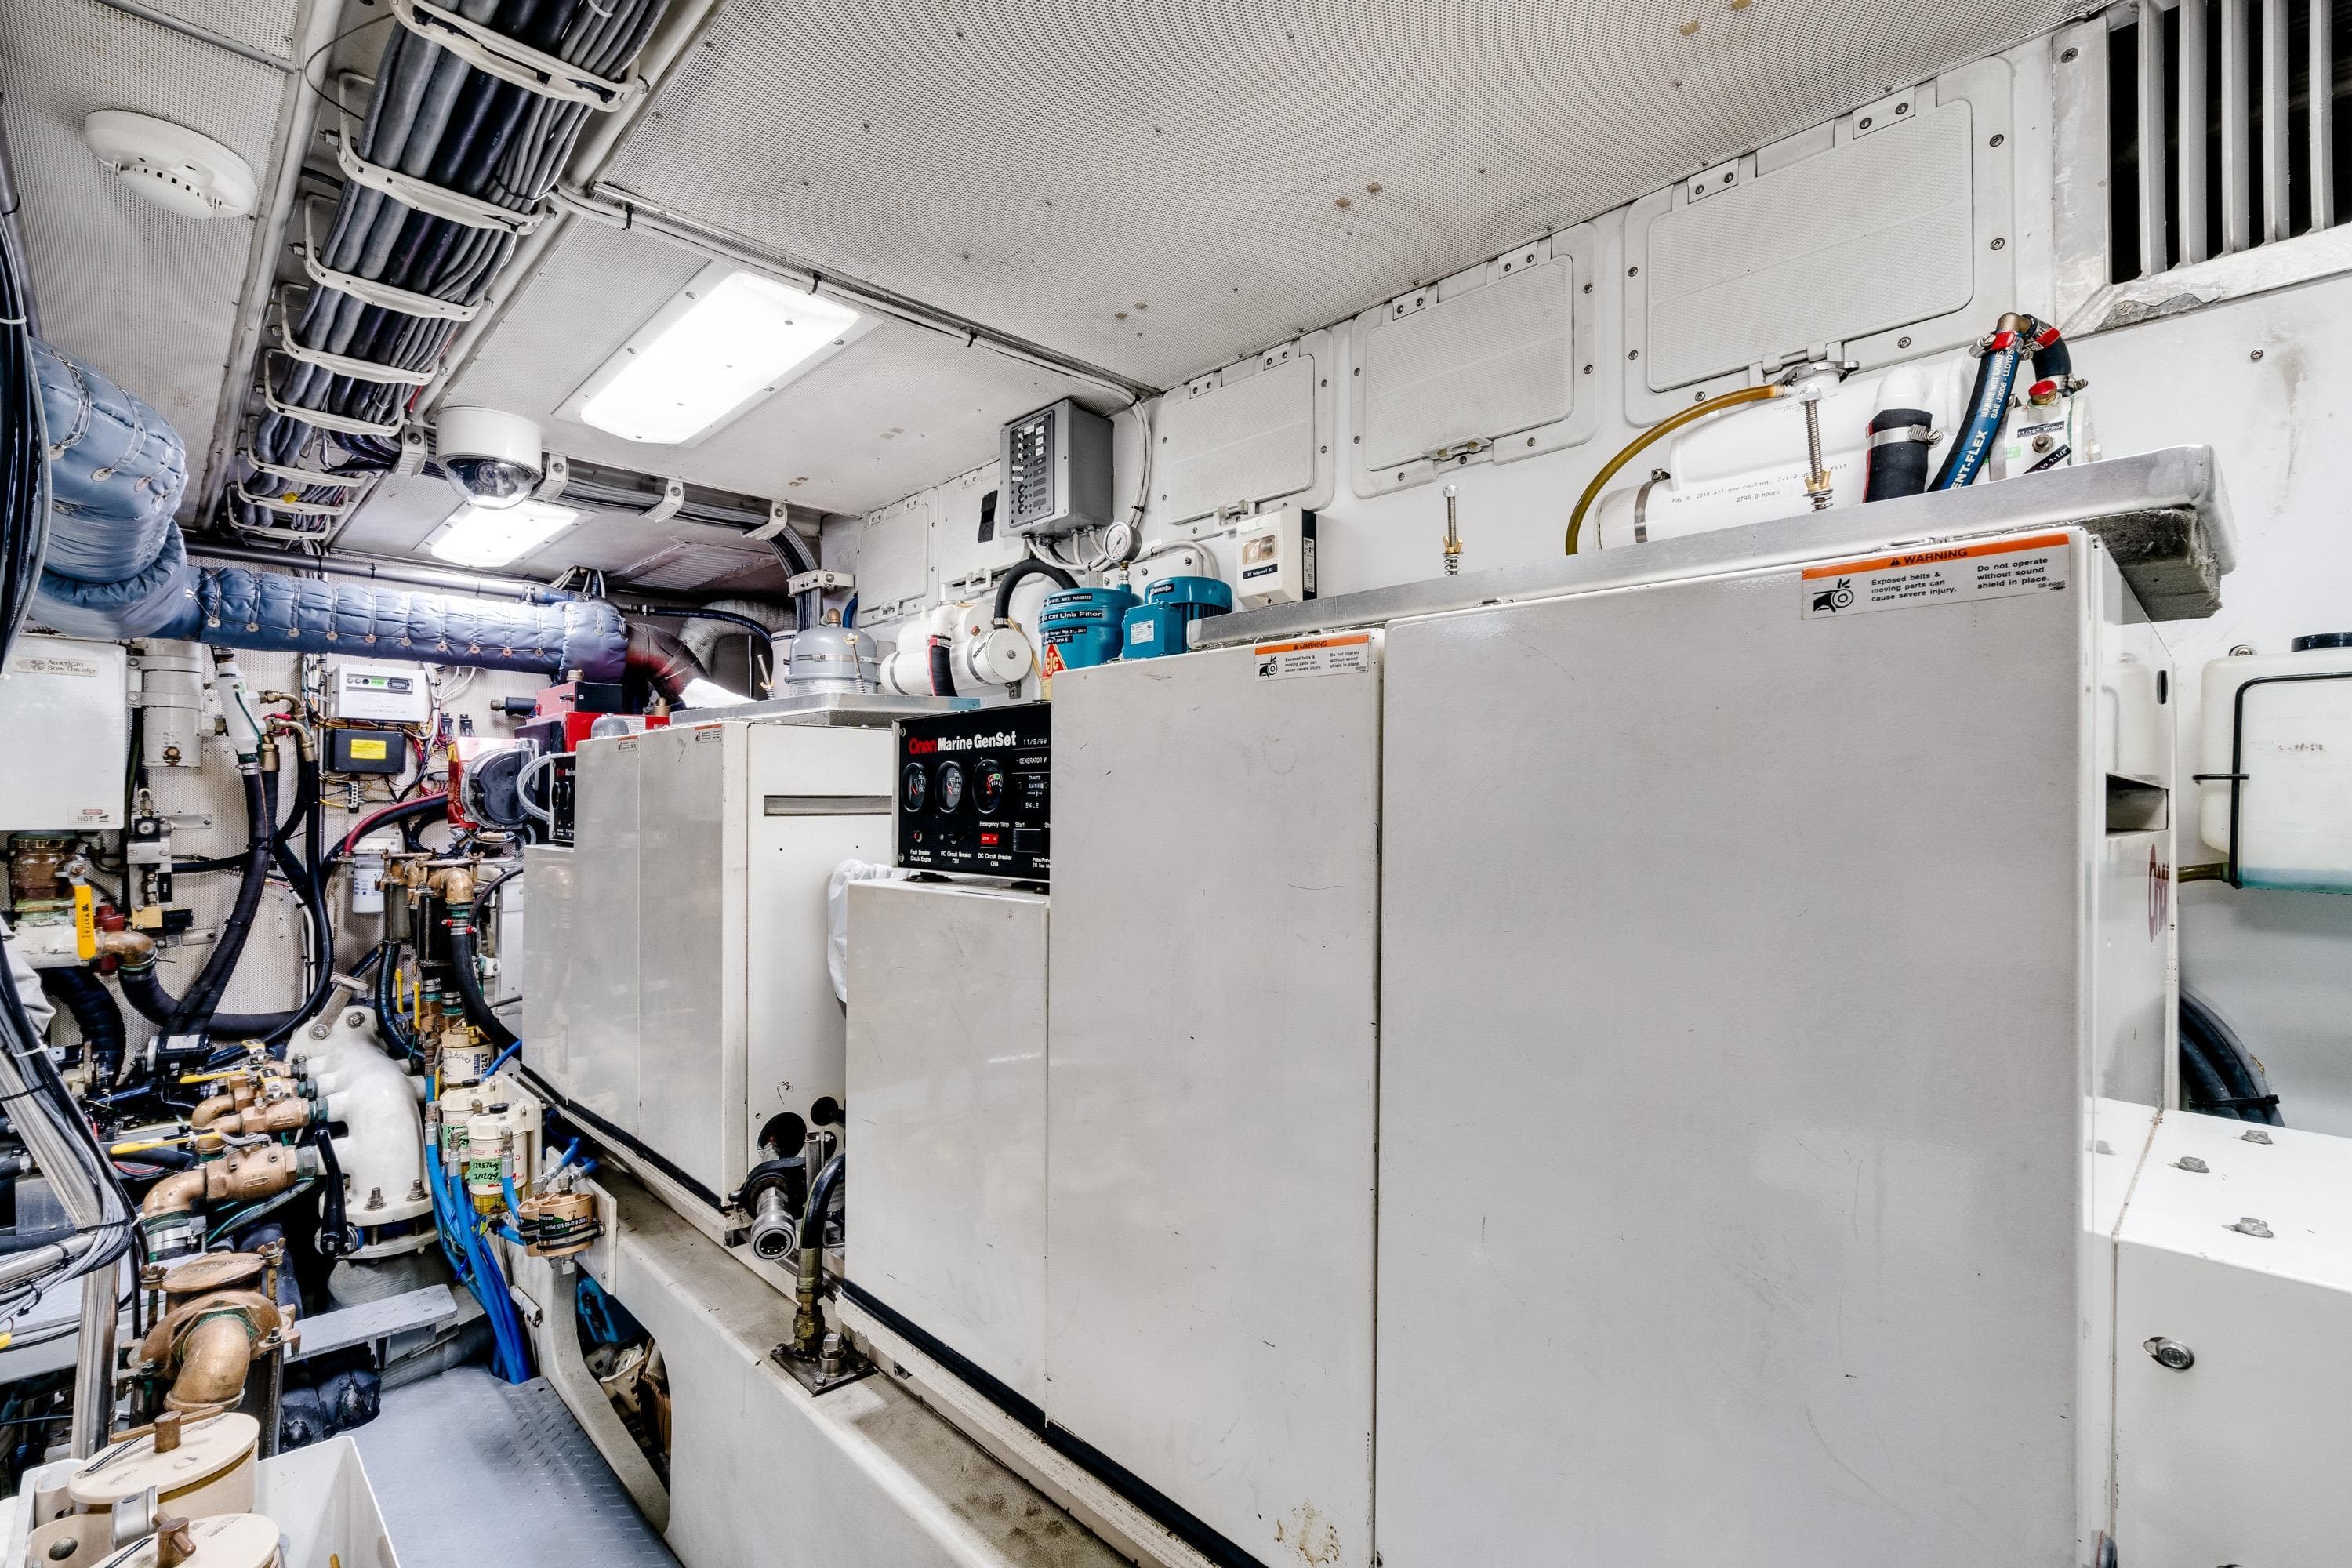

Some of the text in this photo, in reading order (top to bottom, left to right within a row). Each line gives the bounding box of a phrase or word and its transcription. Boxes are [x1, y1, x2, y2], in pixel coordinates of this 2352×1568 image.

[1981, 393, 1992, 418] MARINE
[1991, 403, 2001, 419] SAE
[1997, 382, 2008, 403] J2006
[1904, 548, 1968, 564] WARNING
[1977, 564, 1990, 572] Do
[2013, 557, 2049, 568] operate
[2015, 566, 2045, 575] sound
[1871, 577, 1907, 586] Exposed
[1909, 572, 1930, 581] belts
[1977, 580, 2005, 590] shield
[2022, 575, 2050, 585] place.
[1871, 584, 1902, 593] moving
[1904, 582, 1927, 591] parts
[1930, 586, 1958, 597] injury.
[1045, 653, 1059, 675] CJC
[938, 736, 973, 751] Marine
[974, 731, 1017, 748] GenSet
